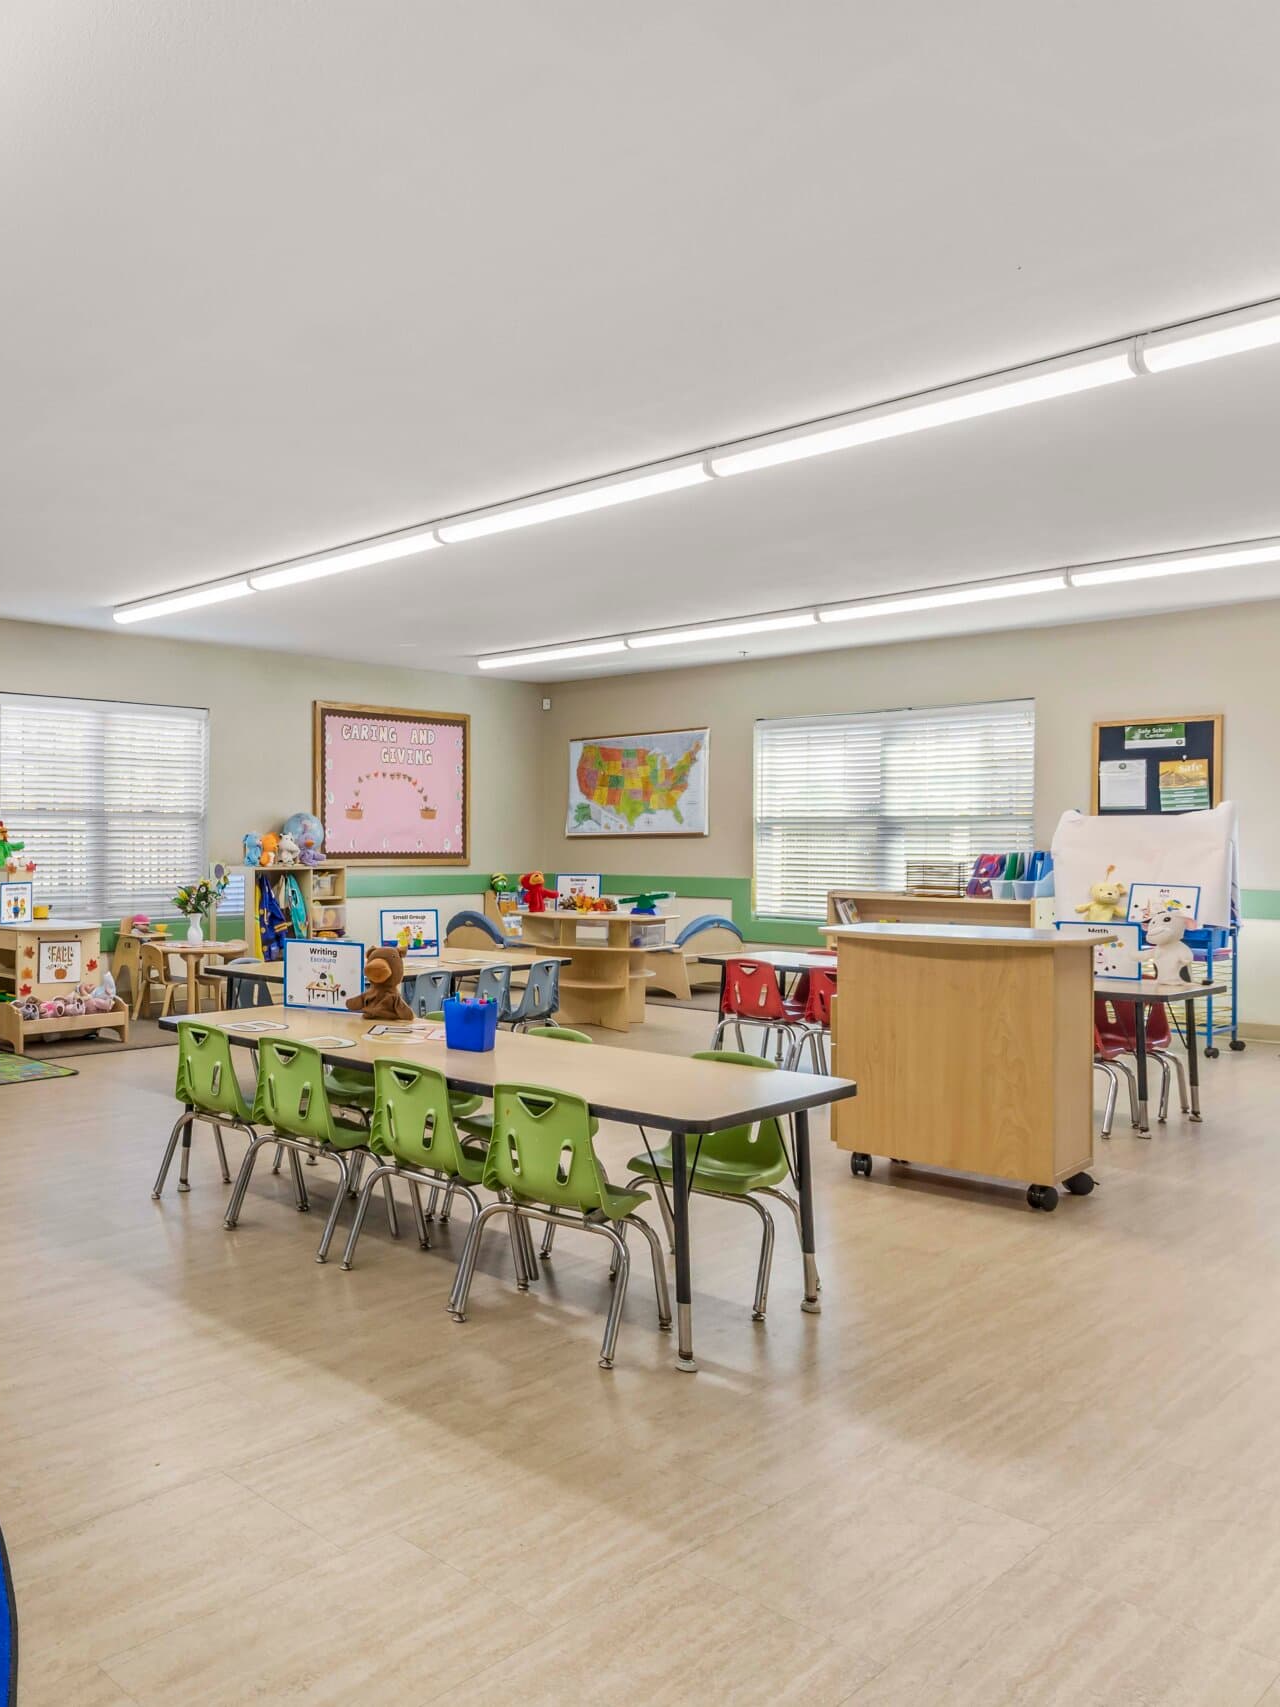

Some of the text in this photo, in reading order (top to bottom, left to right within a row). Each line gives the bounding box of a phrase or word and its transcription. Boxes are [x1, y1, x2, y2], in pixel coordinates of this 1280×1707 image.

[341, 724, 436, 745] CARING AND
[381, 747, 433, 765] GIVING
[309, 947, 338, 958] Writing
